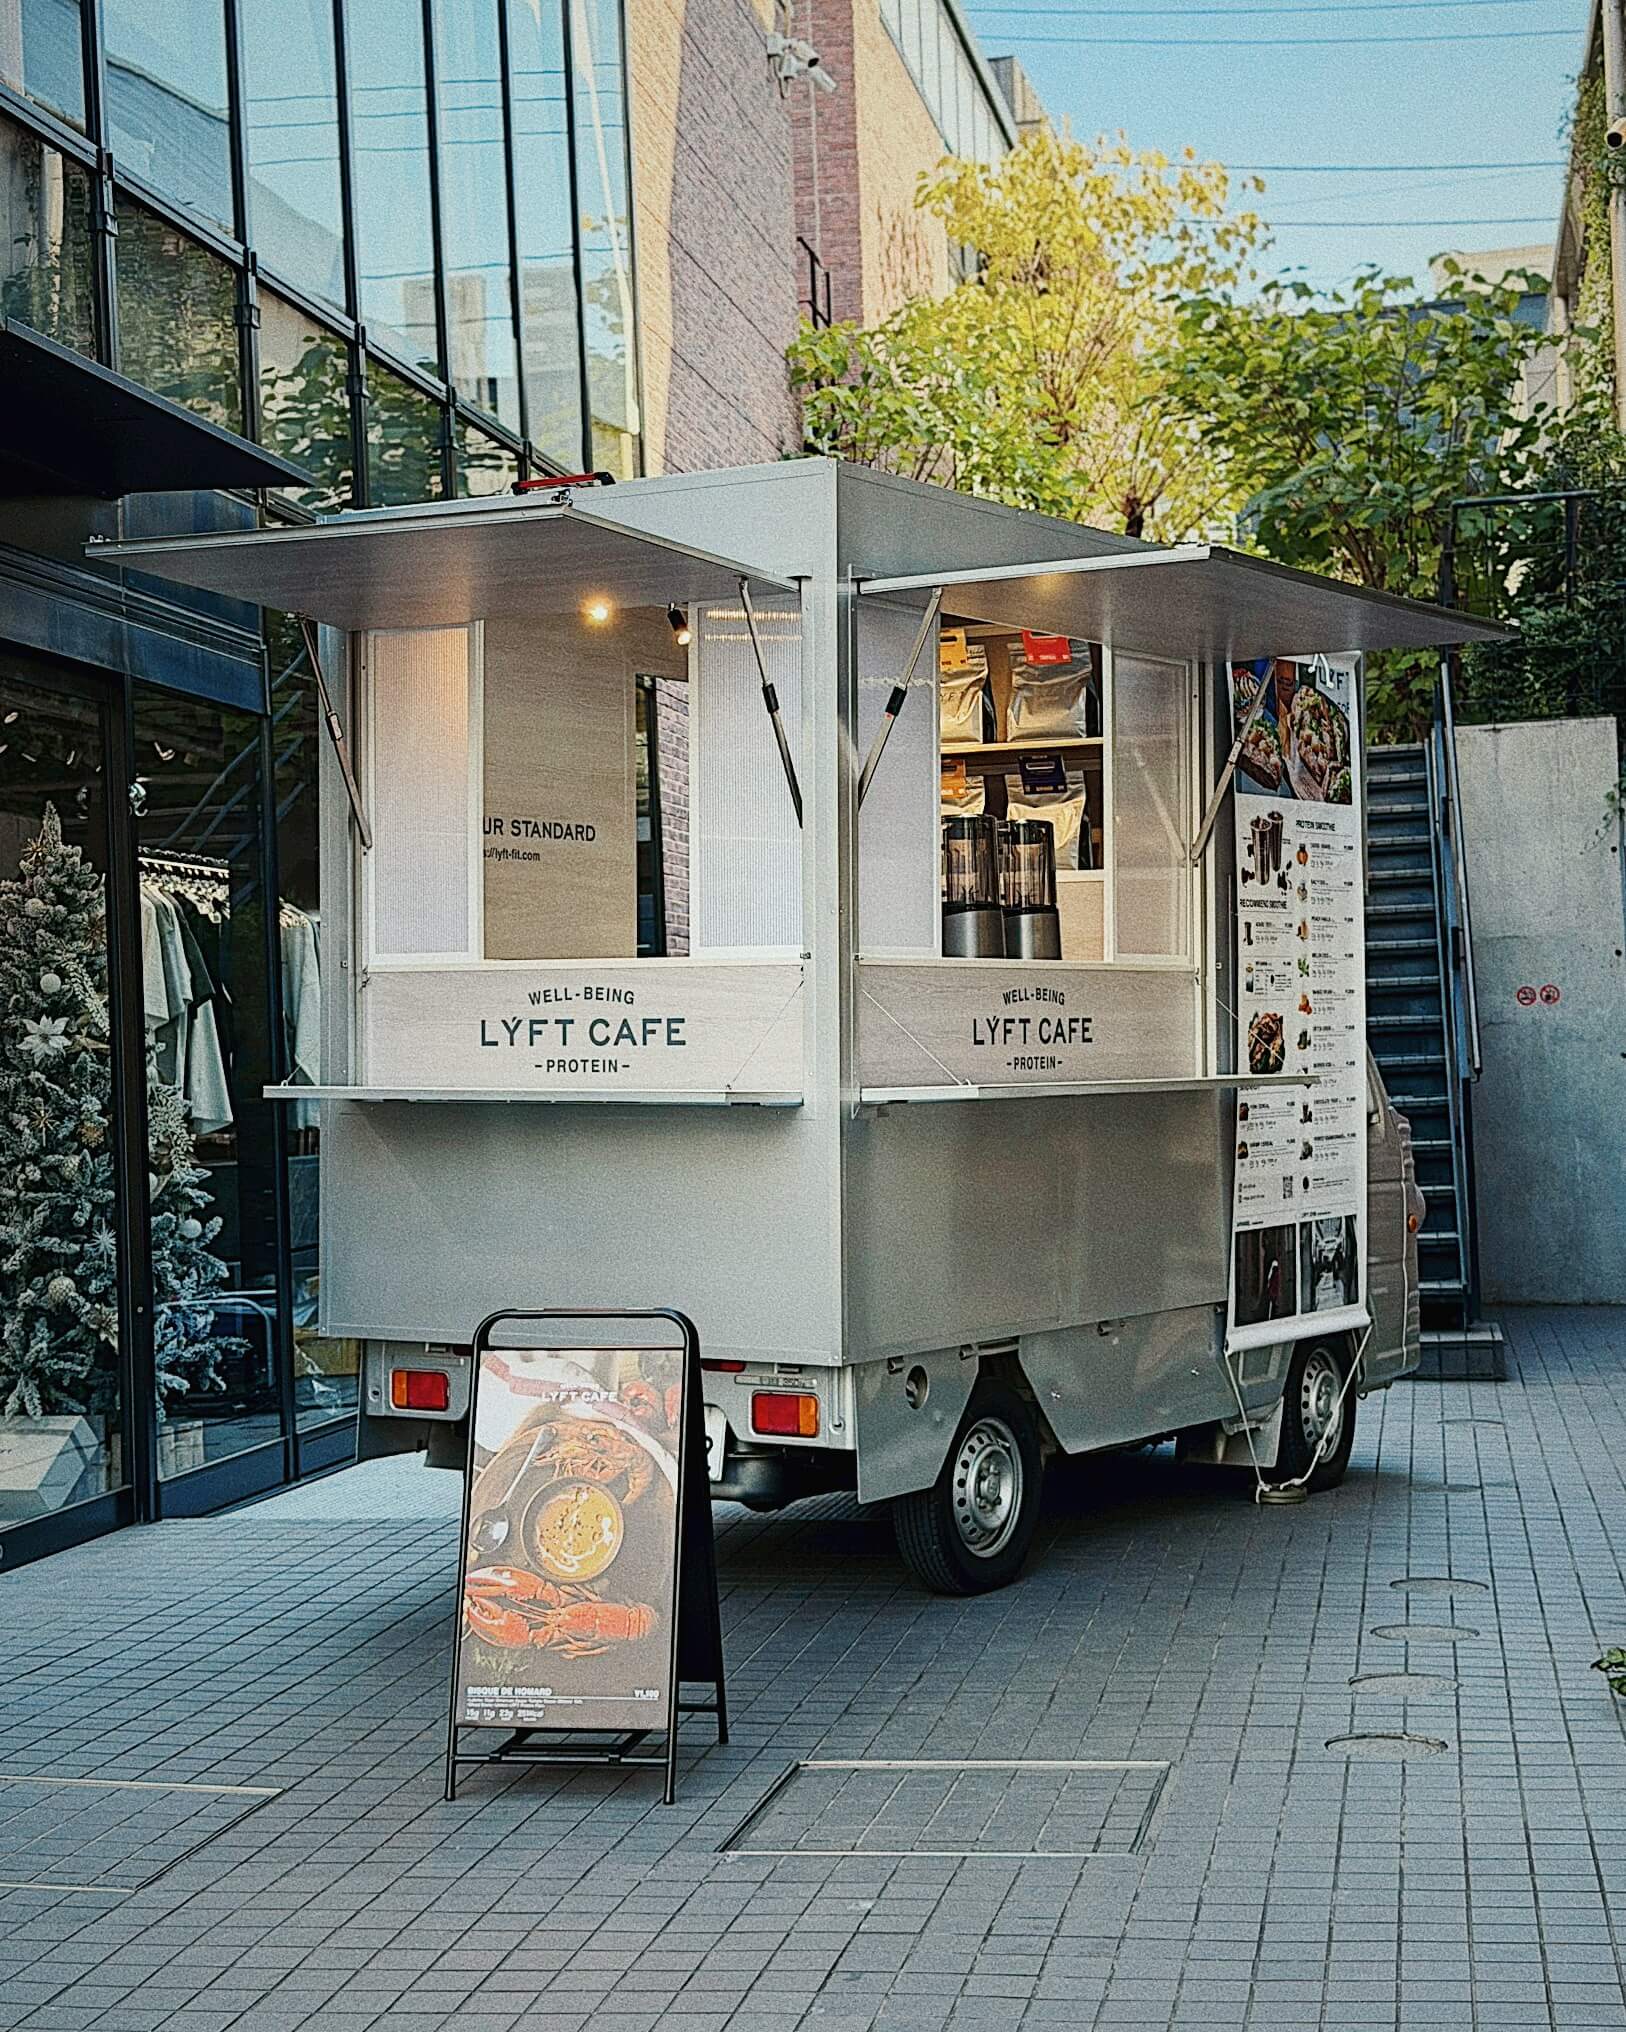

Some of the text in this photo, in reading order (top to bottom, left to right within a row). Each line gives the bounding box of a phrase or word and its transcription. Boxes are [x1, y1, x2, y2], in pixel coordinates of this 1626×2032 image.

[511, 819, 596, 842] STANDARD
[528, 986, 635, 1006] WELL-BEING
[1002, 987, 1065, 1006] WELL-BEING
[588, 1017, 687, 1046] CAFE
[1038, 1017, 1093, 1044] CAFE
[581, 1391, 618, 1402] CAFE
